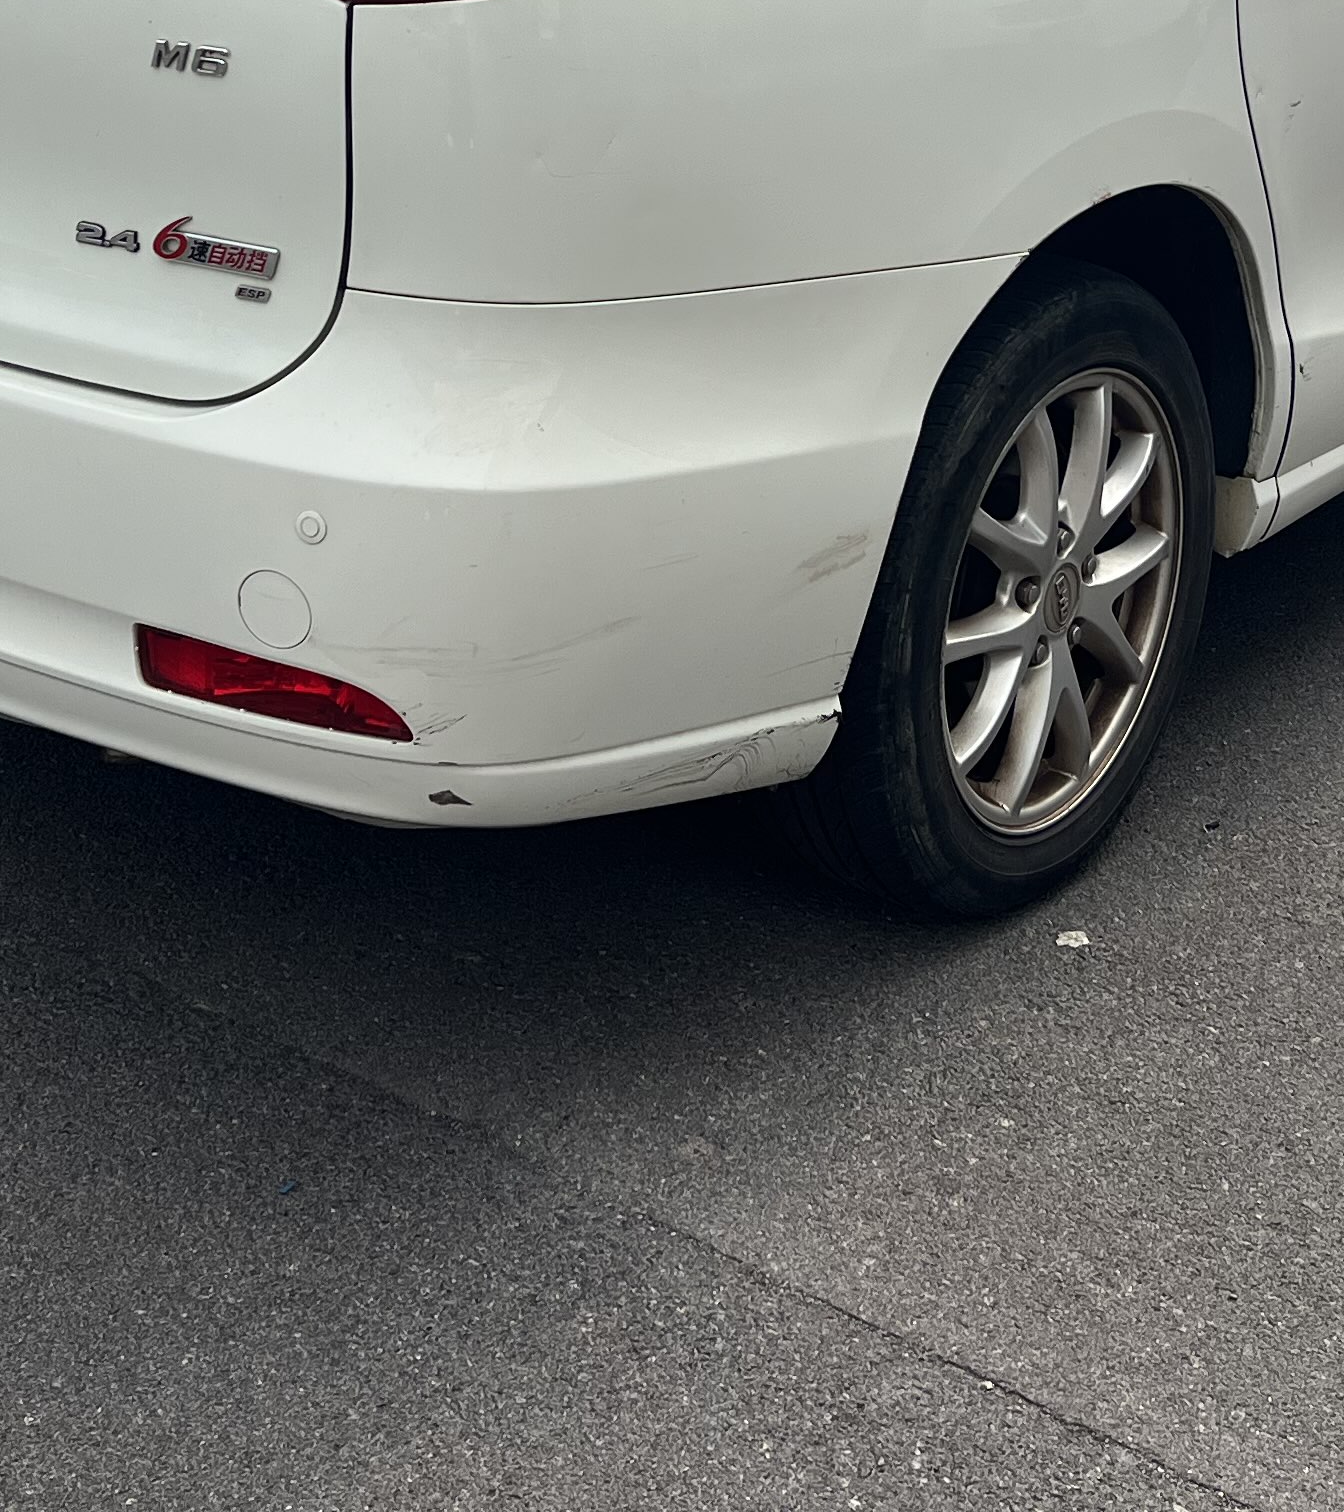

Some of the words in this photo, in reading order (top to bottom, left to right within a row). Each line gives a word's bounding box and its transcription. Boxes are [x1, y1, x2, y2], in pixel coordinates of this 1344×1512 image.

[150, 38, 232, 78] M6
[75, 220, 141, 253] 2.4
[238, 287, 267, 300] ESP
